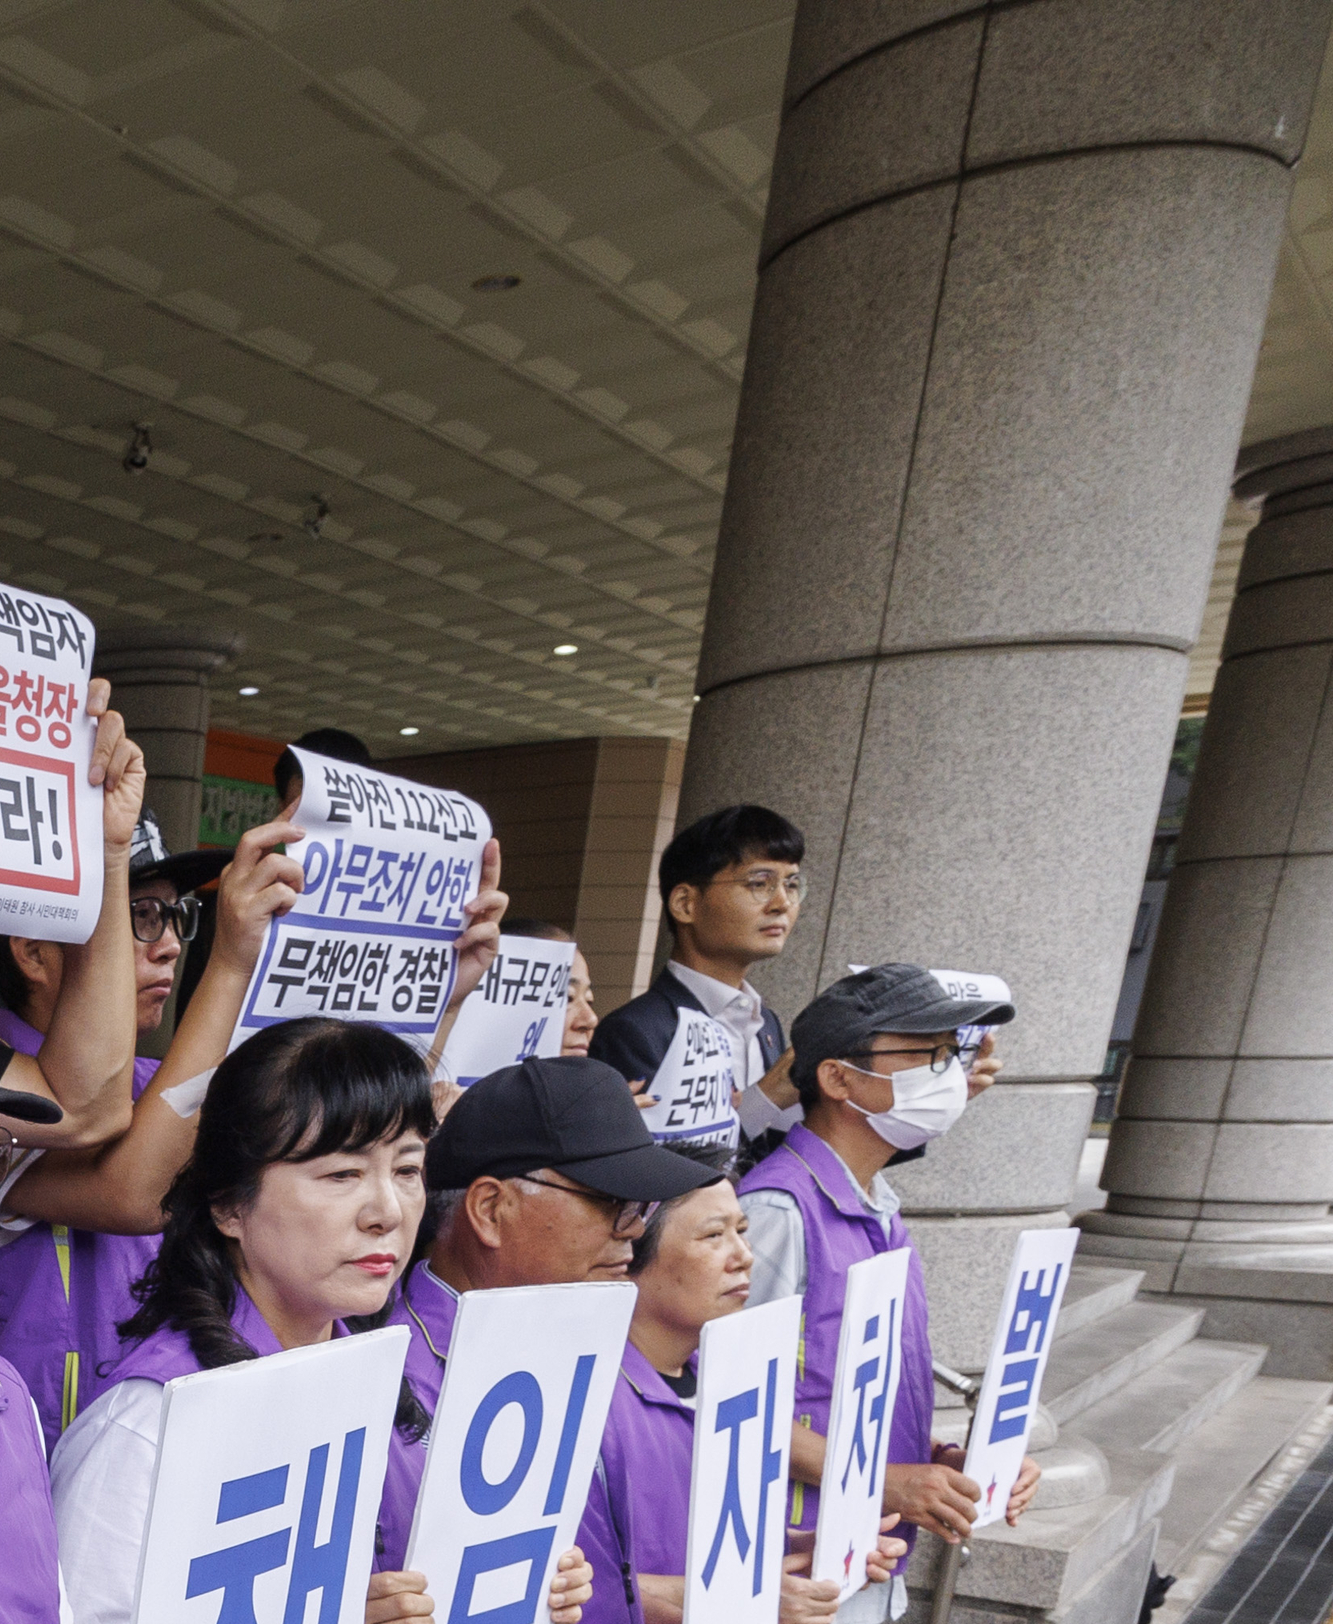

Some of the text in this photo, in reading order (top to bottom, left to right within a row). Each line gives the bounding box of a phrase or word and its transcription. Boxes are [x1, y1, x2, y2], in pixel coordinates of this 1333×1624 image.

[322, 765, 397, 832] 쏟아진
[20, 900, 36, 919] 참사
[37, 903, 80, 922] 시민대책회의
[301, 838, 474, 929] 아무조치 안한
[267, 937, 449, 1014] 무책임한 경찰
[840, 1297, 897, 1498] 처
[987, 1262, 1065, 1446] 벌
[700, 1356, 783, 1598] 자
